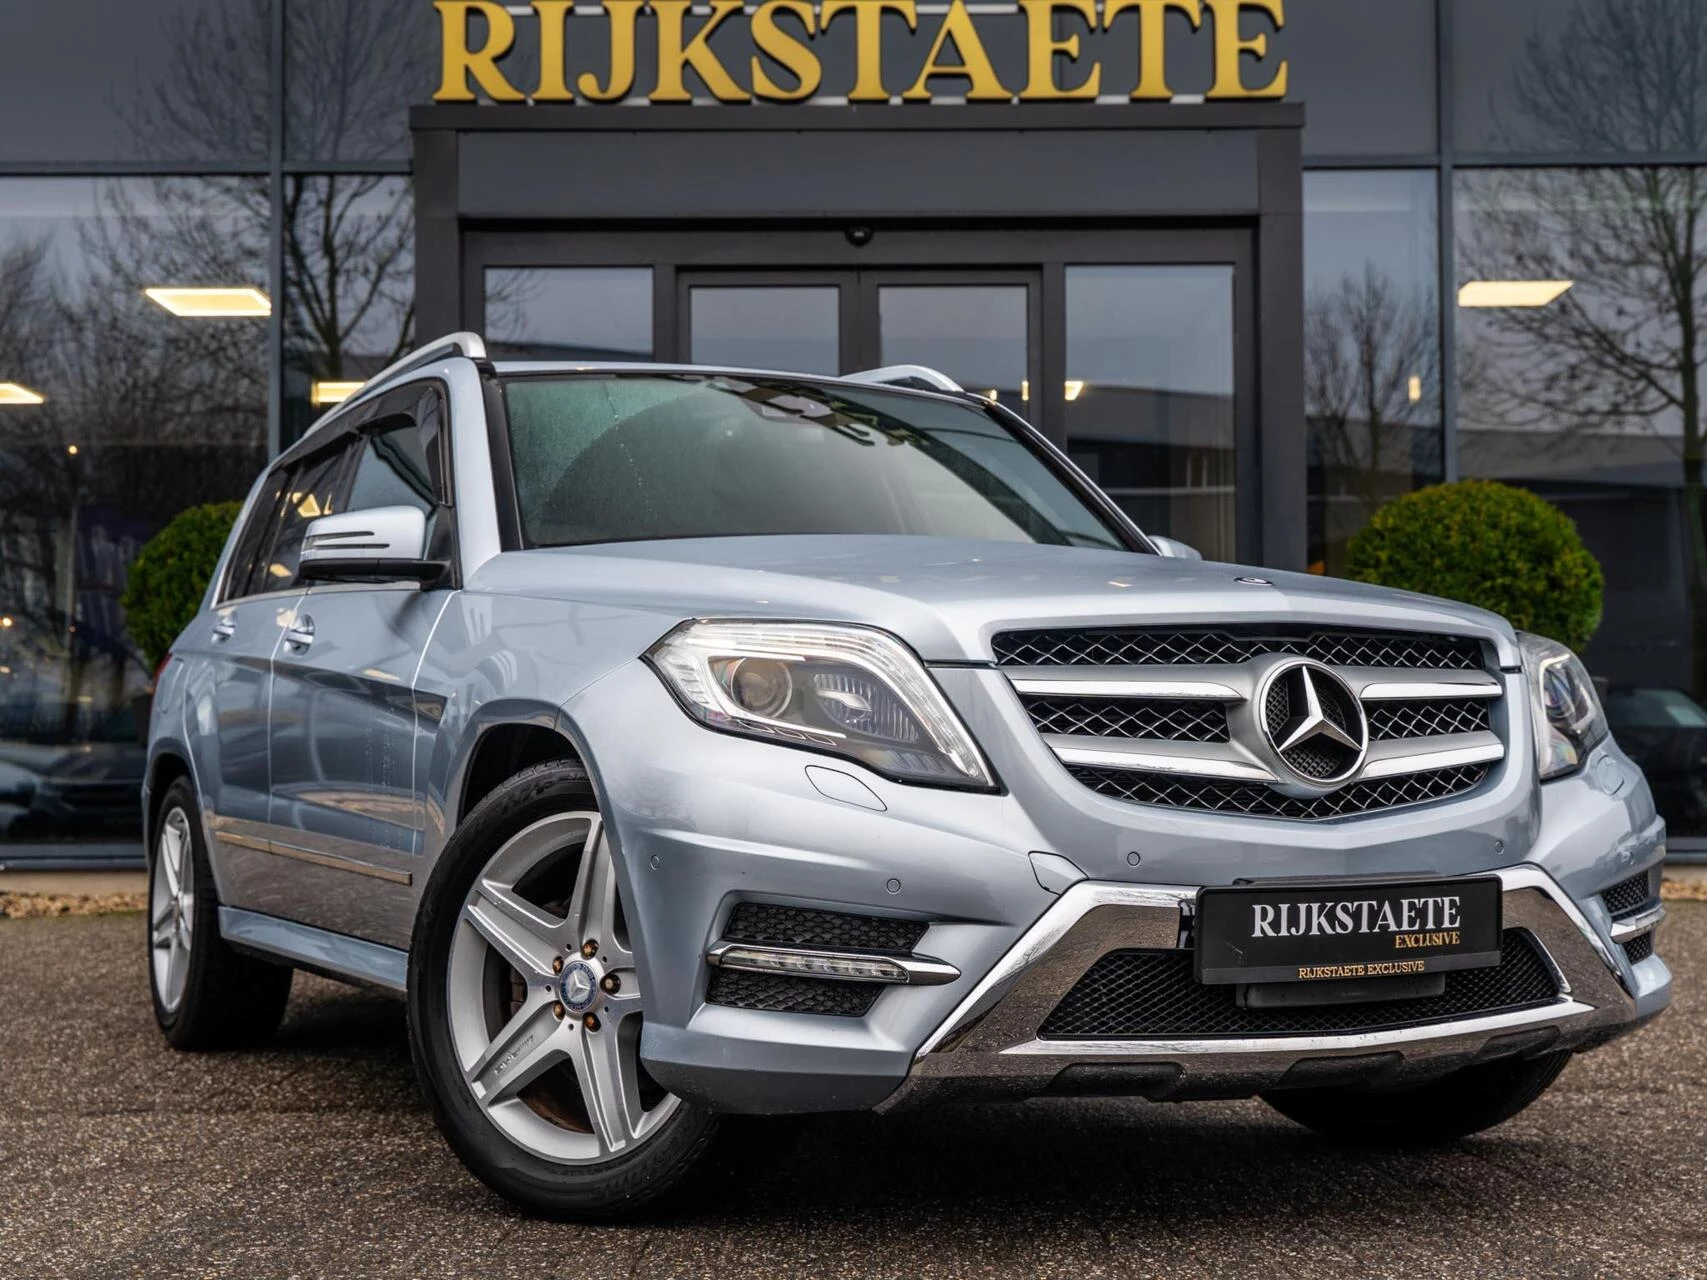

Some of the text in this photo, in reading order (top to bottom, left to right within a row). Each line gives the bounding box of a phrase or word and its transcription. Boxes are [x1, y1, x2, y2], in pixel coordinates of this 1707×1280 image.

[433, 0, 1289, 101] RIJKSTAETE
[1251, 897, 1461, 938] RIJKSTAETE
[1394, 931, 1460, 949] EXCLUSIVE
[1298, 960, 1425, 979] RIJKSTAETE EXCLUSIVE
